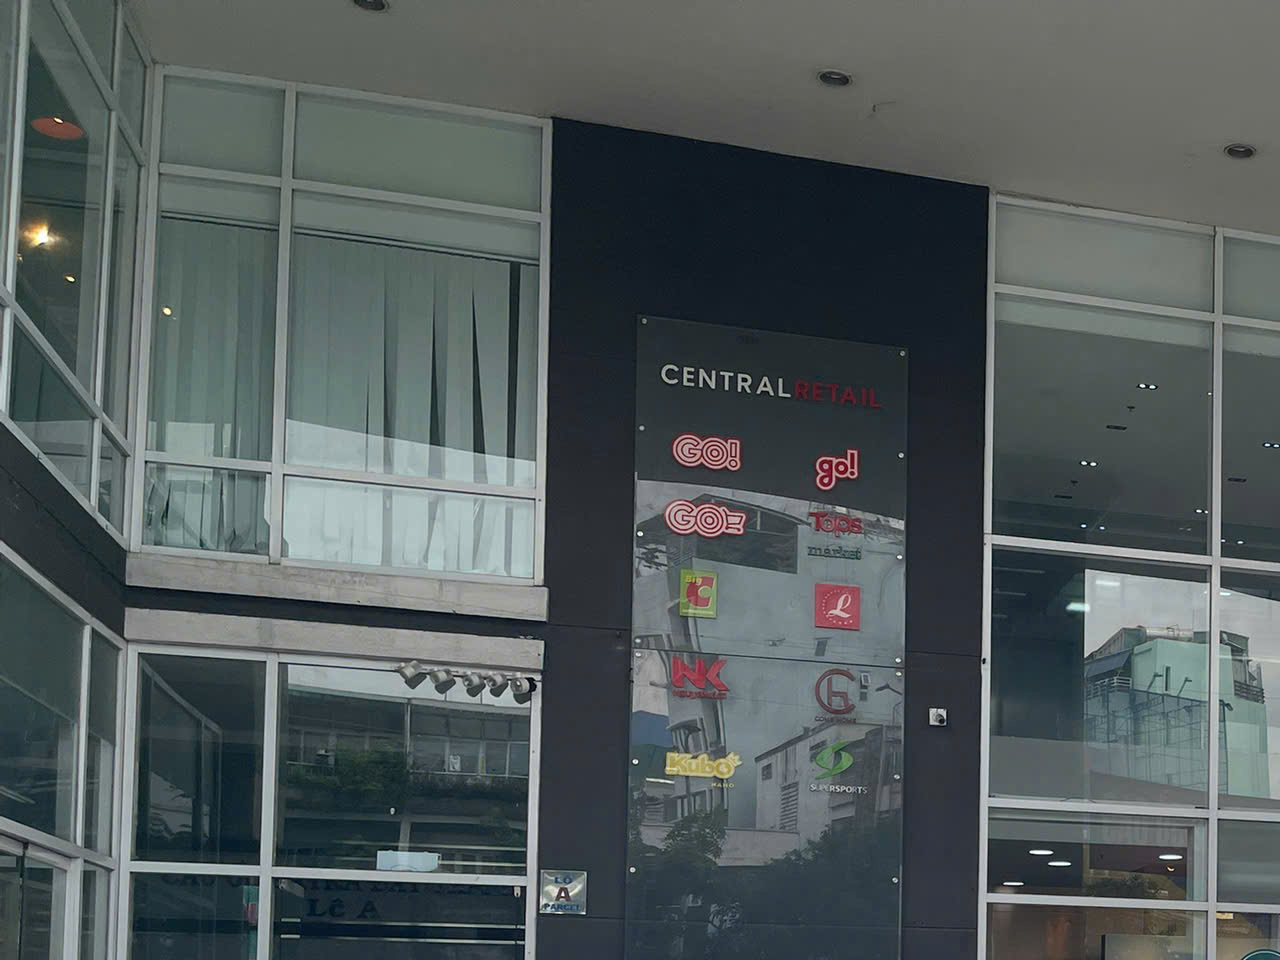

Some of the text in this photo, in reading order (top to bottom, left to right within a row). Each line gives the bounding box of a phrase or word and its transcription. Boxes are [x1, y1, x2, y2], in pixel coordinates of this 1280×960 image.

[672, 433, 741, 471] GO!
[815, 449, 858, 490] go!
[808, 511, 864, 538] Tops
[808, 546, 862, 560] market
[685, 574, 702, 586] Big
[672, 655, 729, 691] NK
[665, 752, 737, 779] Kubo
[809, 783, 868, 794] SUPERSPORTS
[555, 886, 571, 902] A
